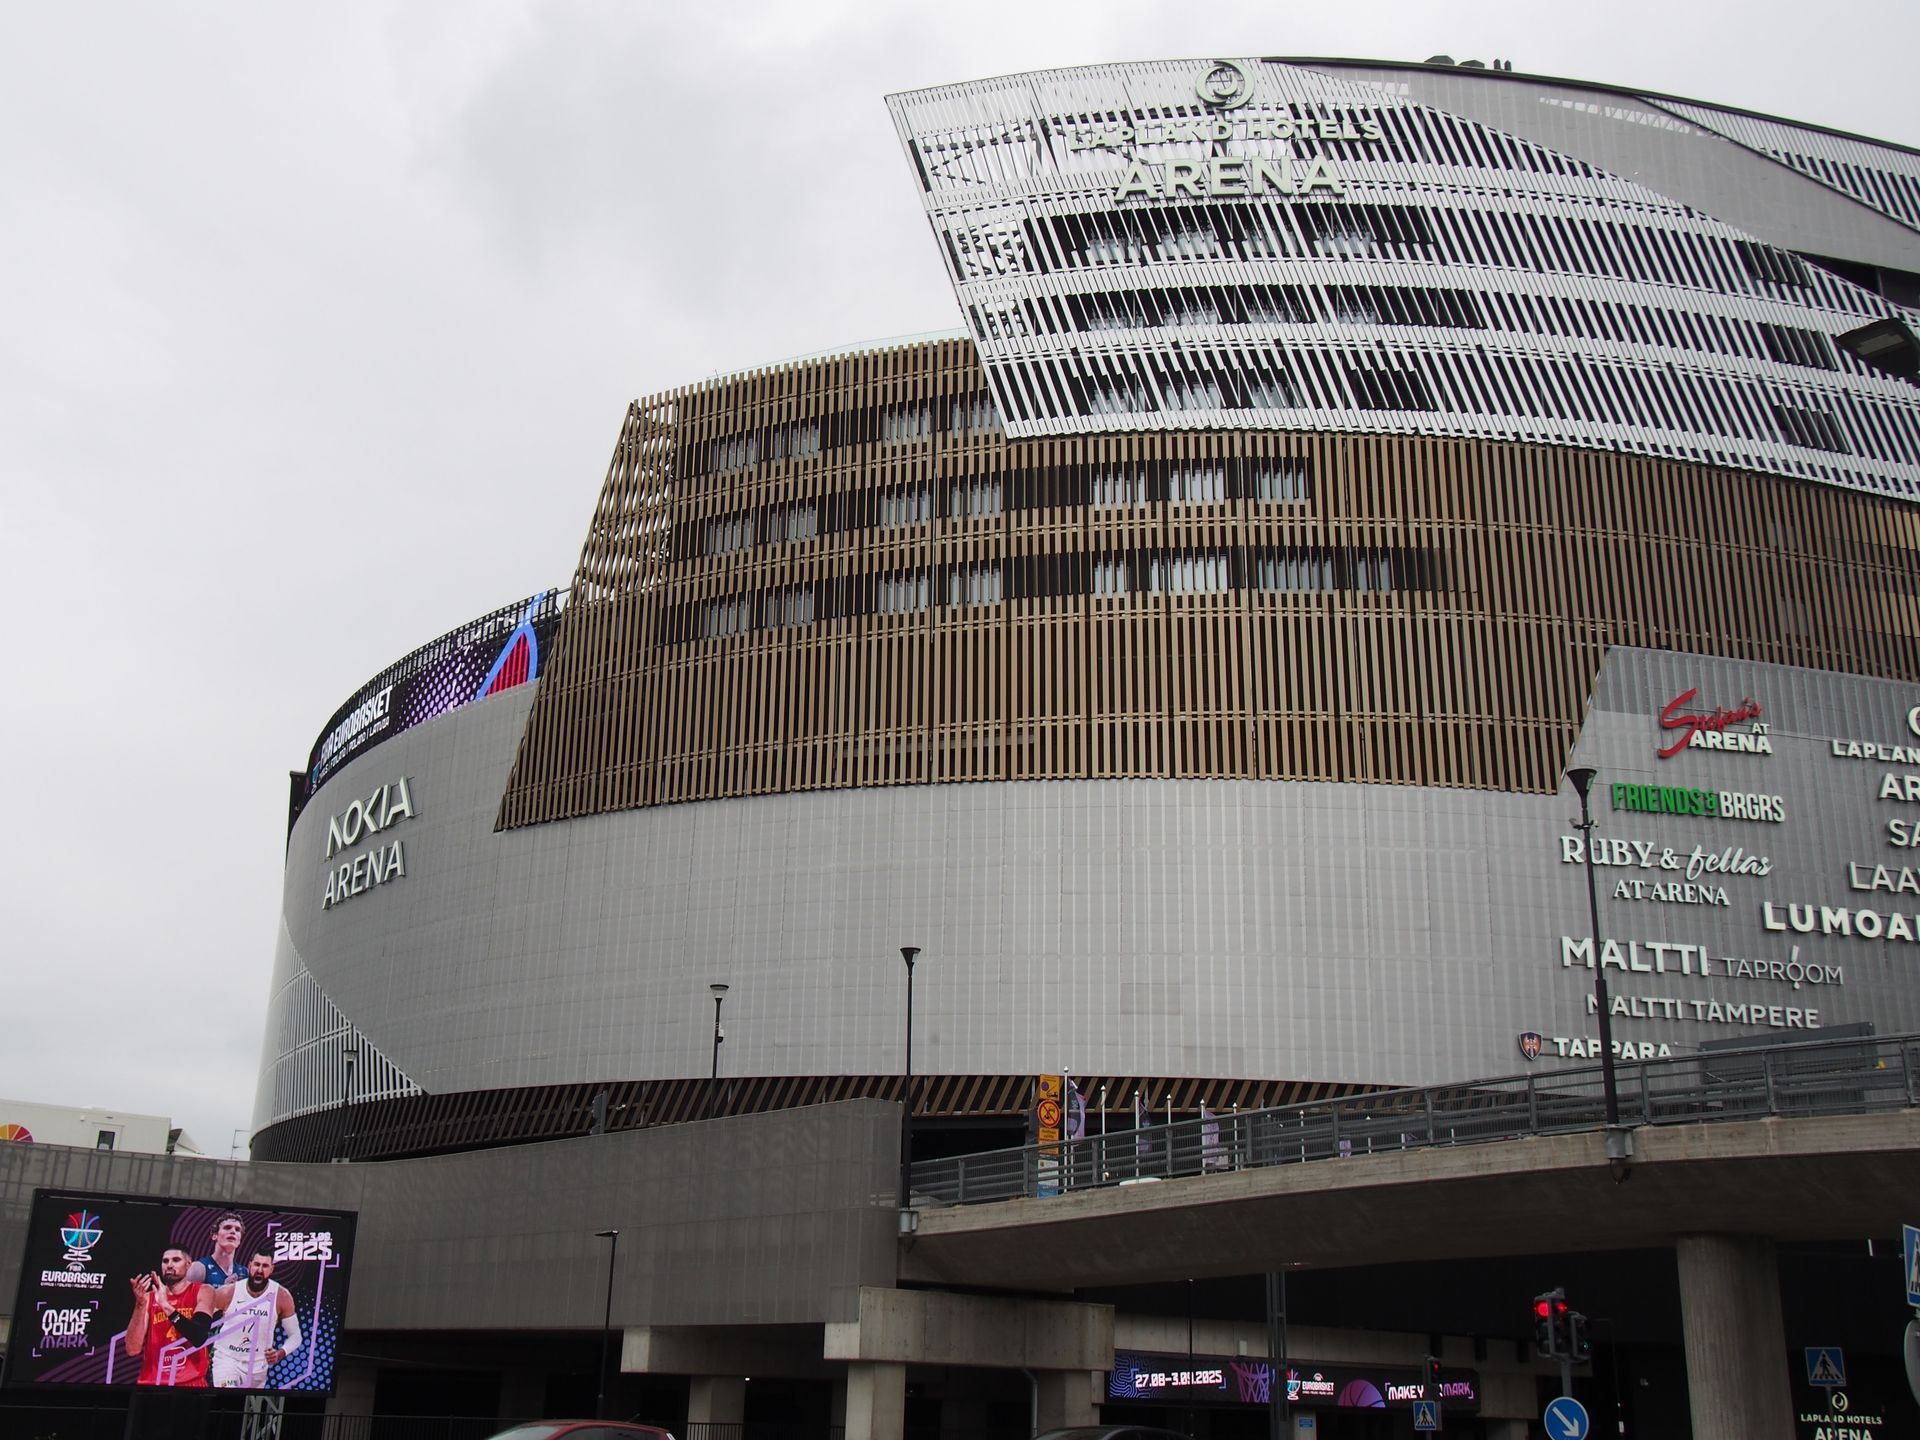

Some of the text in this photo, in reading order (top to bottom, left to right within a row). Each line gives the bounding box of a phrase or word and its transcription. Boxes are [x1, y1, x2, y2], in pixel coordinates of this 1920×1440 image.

[1070, 119, 1381, 151] LAPLAND HOTELS
[1114, 155, 1345, 203] ARENA
[333, 684, 393, 753] EUROBASKET
[1752, 722, 1770, 735] AT
[1688, 730, 1773, 755] ARENA
[1613, 782, 1702, 816] FRIENDS
[1719, 791, 1786, 823] BRGRS
[326, 776, 415, 860] NOKIA
[1560, 835, 1774, 881] RUBY & fellas
[322, 840, 406, 910] ARENA
[1613, 879, 1732, 906] AT ARENA
[1561, 935, 1709, 976] MALTTI
[1690, 999, 1820, 1029] TAMPERE
[273, 1241, 333, 1260] 2025
[41, 1270, 107, 1284] EUROBASKET
[42, 1308, 92, 1322] MAKE
[40, 1334, 89, 1349] MARK
[41, 1322, 86, 1336] YOUR
[1388, 1385, 1417, 1400] MAKE
[1443, 1382, 1470, 1396] MARK
[1847, 1415, 1882, 1425] HOTELS
